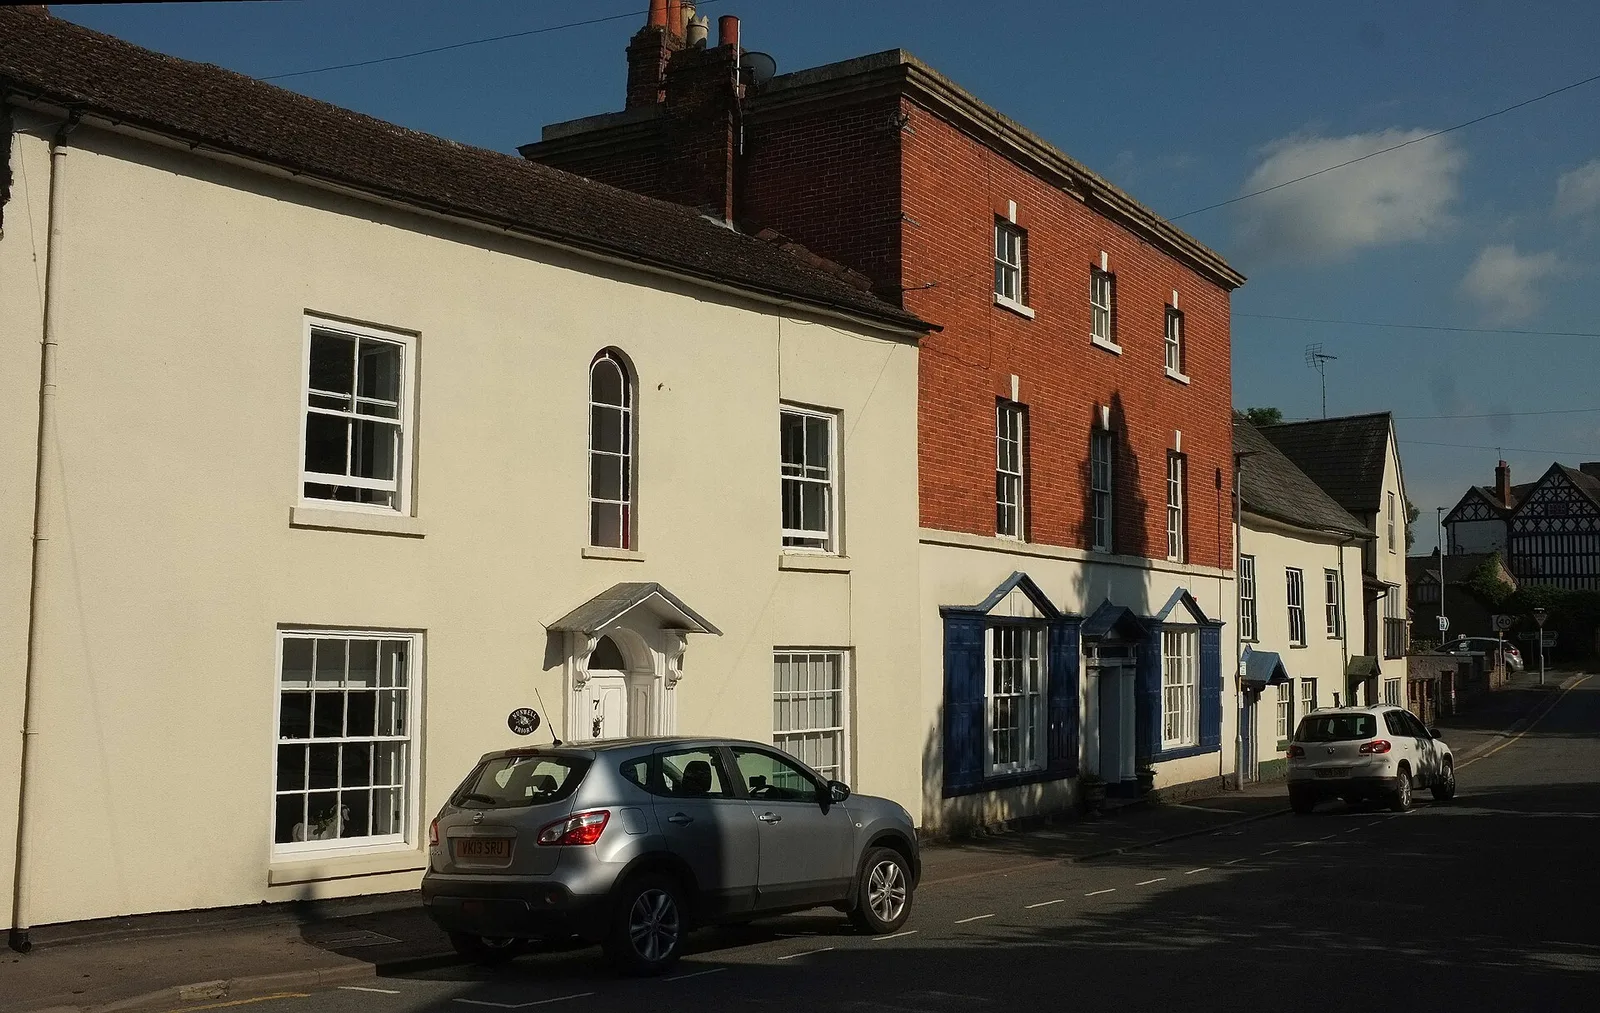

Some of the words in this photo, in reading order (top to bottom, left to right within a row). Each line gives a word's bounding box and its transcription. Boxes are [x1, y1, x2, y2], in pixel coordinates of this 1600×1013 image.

[1499, 618, 1511, 626] 40
[593, 699, 600, 710] 7
[514, 725, 533, 734] PRIORY
[484, 841, 503, 855] SRU
